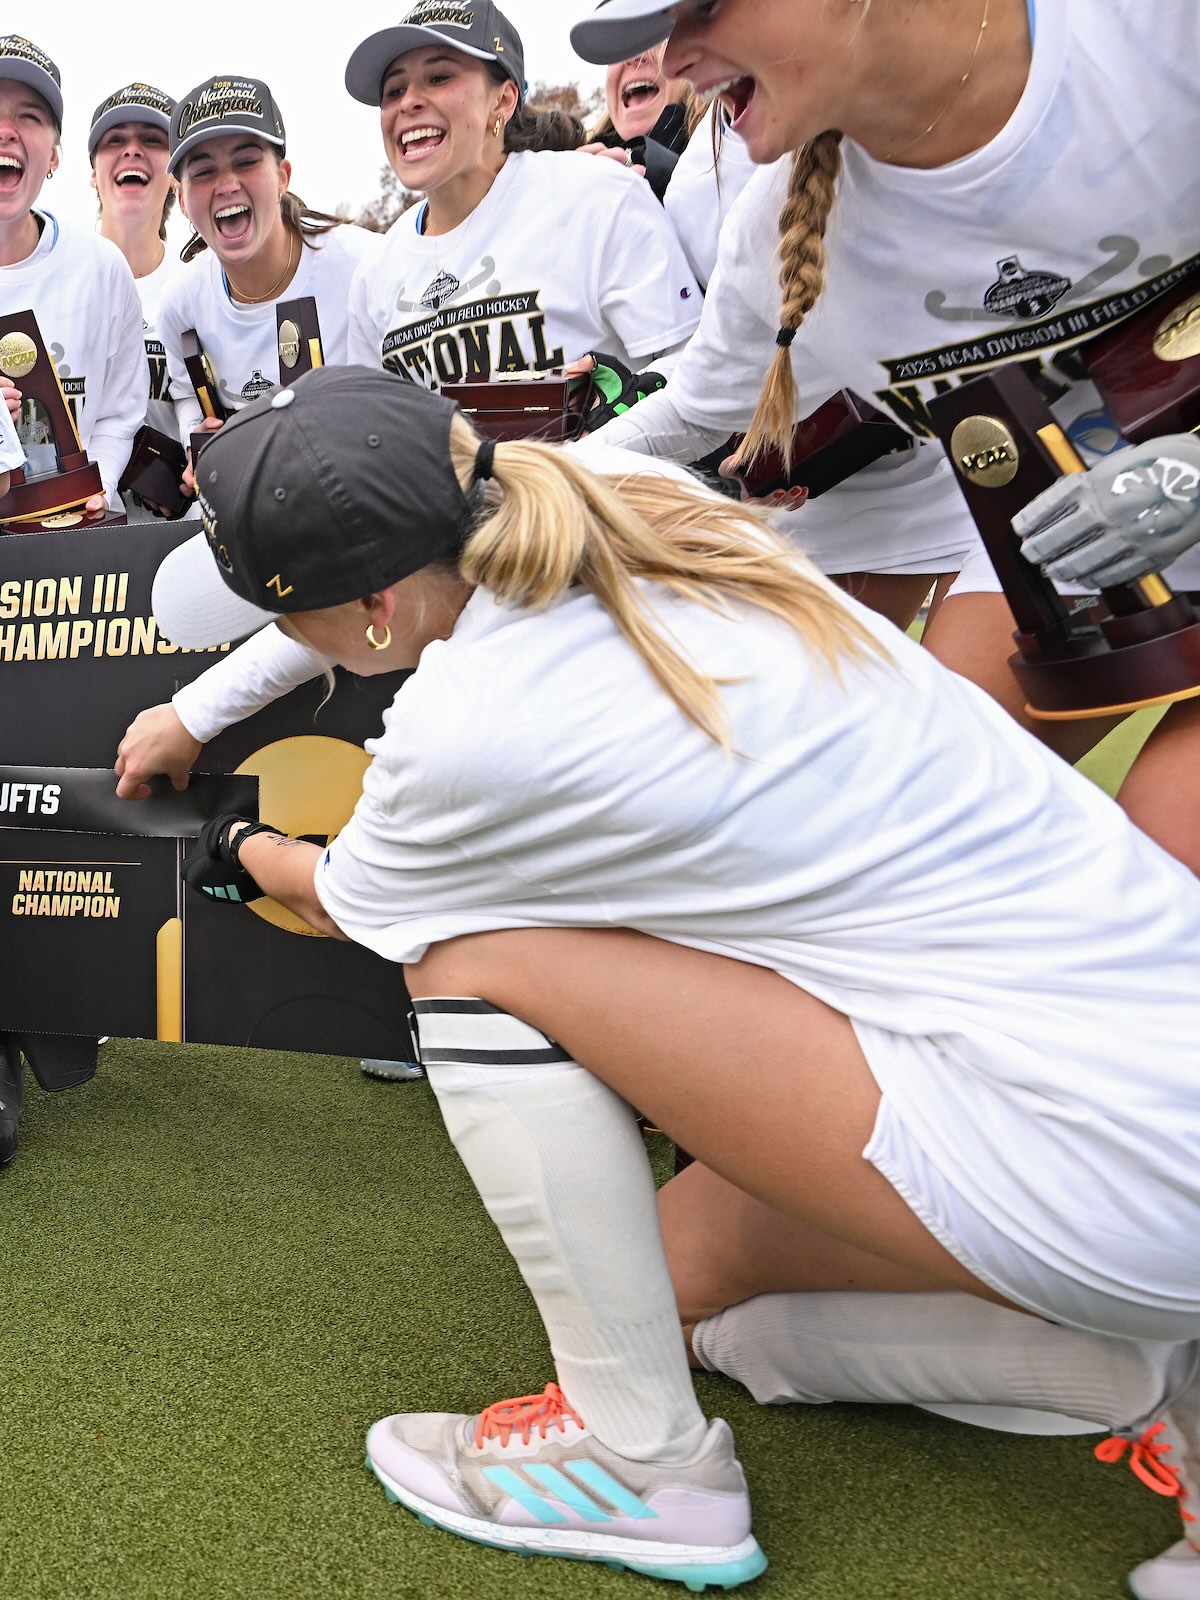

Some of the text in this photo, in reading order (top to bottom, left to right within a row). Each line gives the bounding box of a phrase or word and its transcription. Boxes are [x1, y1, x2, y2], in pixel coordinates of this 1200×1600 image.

[120, 87, 169, 105] National
[198, 87, 257, 107] National
[178, 99, 264, 140] Champions
[458, 304, 484, 323] FIELD
[486, 296, 531, 316] HOCKEY
[897, 357, 938, 379] 2025
[938, 348, 985, 368] NCAA
[986, 324, 1065, 357] DIVISION
[1094, 288, 1149, 323] FIELD
[1, 348, 36, 369] NCAA
[91, 572, 129, 614] III
[18, 870, 115, 894] NATIONAL
[11, 894, 121, 918] CHAMPION
